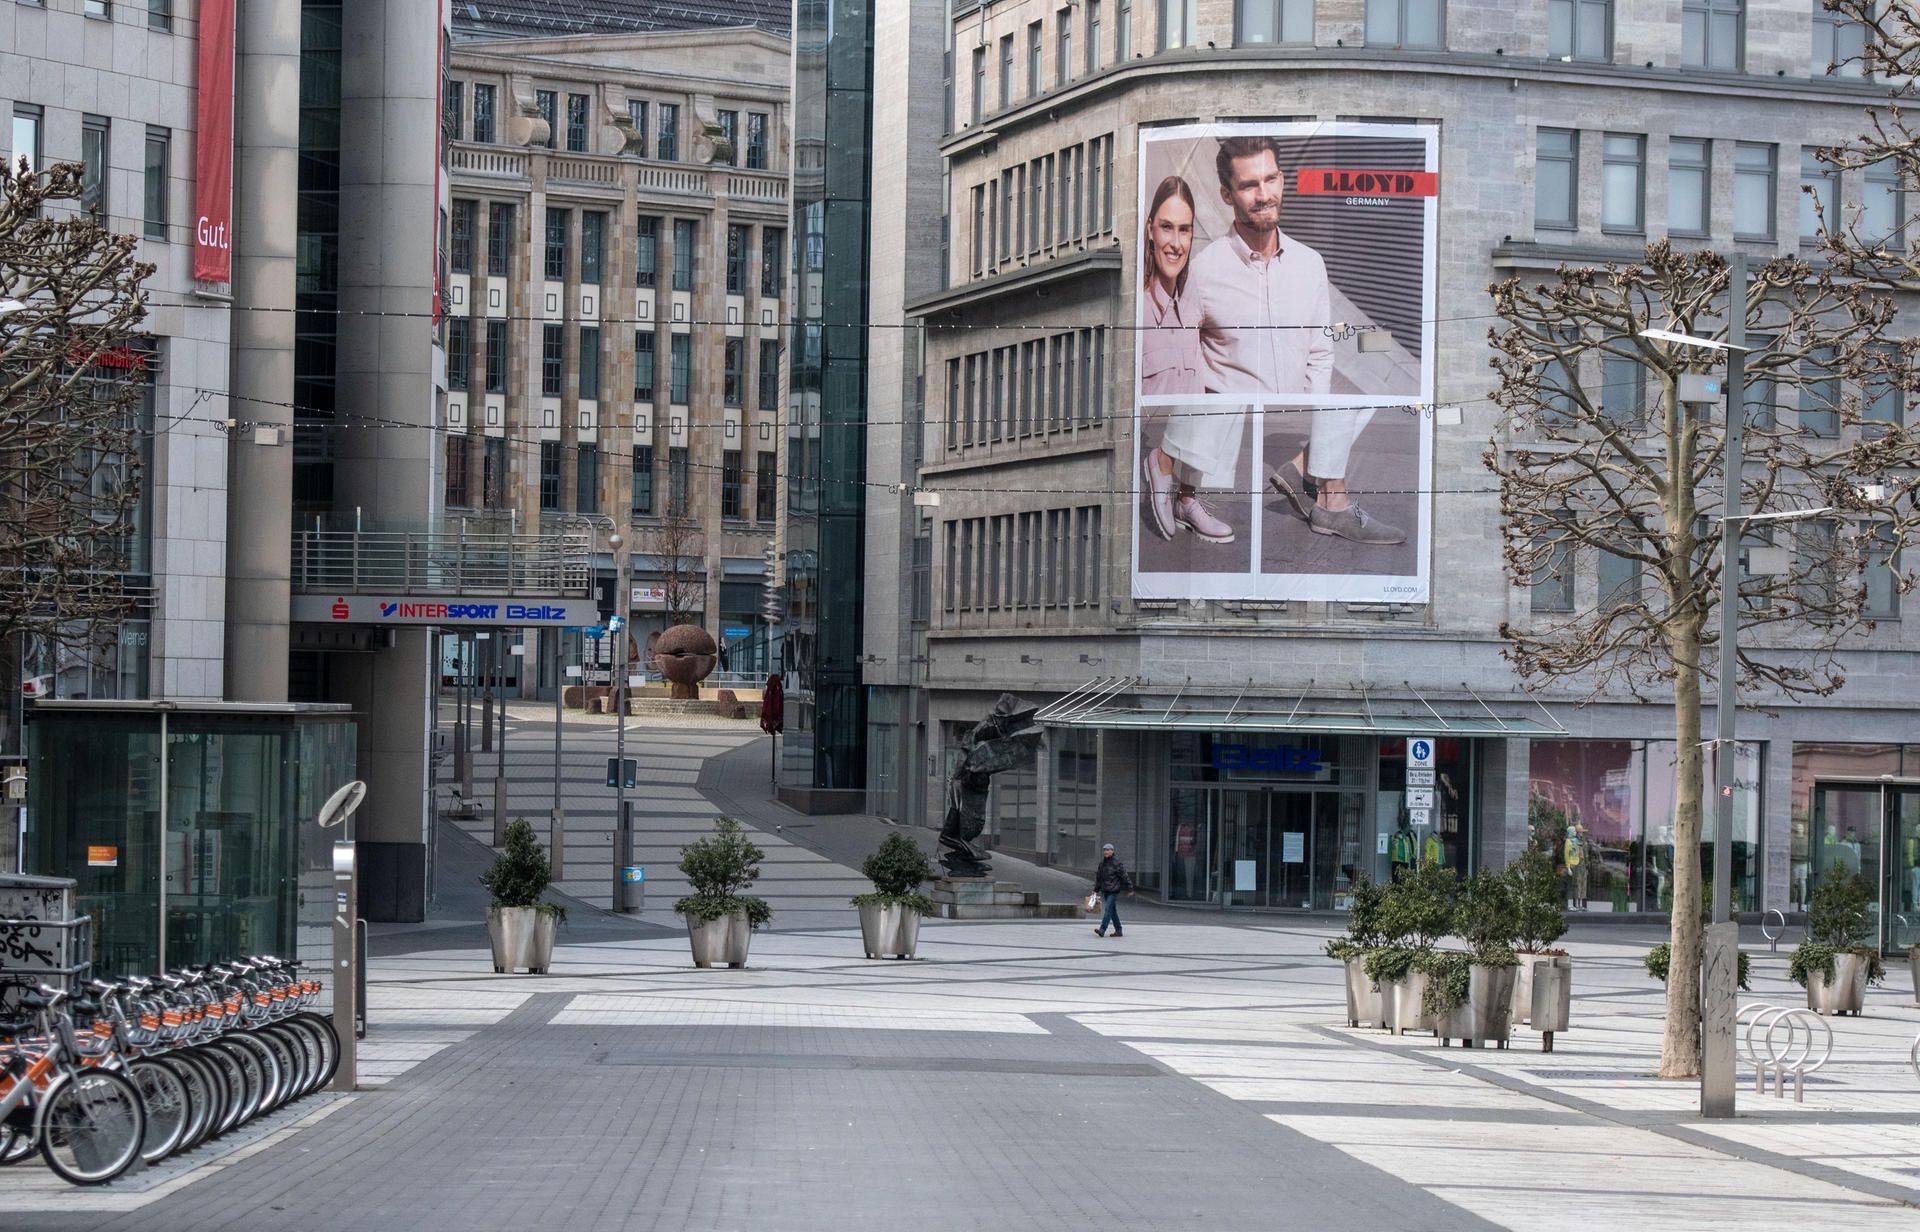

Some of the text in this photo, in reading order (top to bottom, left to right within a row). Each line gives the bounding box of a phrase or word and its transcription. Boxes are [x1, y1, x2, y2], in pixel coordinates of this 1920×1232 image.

[1323, 172, 1414, 193] LLOYD
[1345, 197, 1390, 206] GERMANY
[197, 215, 228, 249] Gut.
[1383, 585, 1418, 593] LLOYD.COM
[399, 603, 566, 620] INTERSPORT Baltz
[1211, 743, 1323, 772] Baltz
